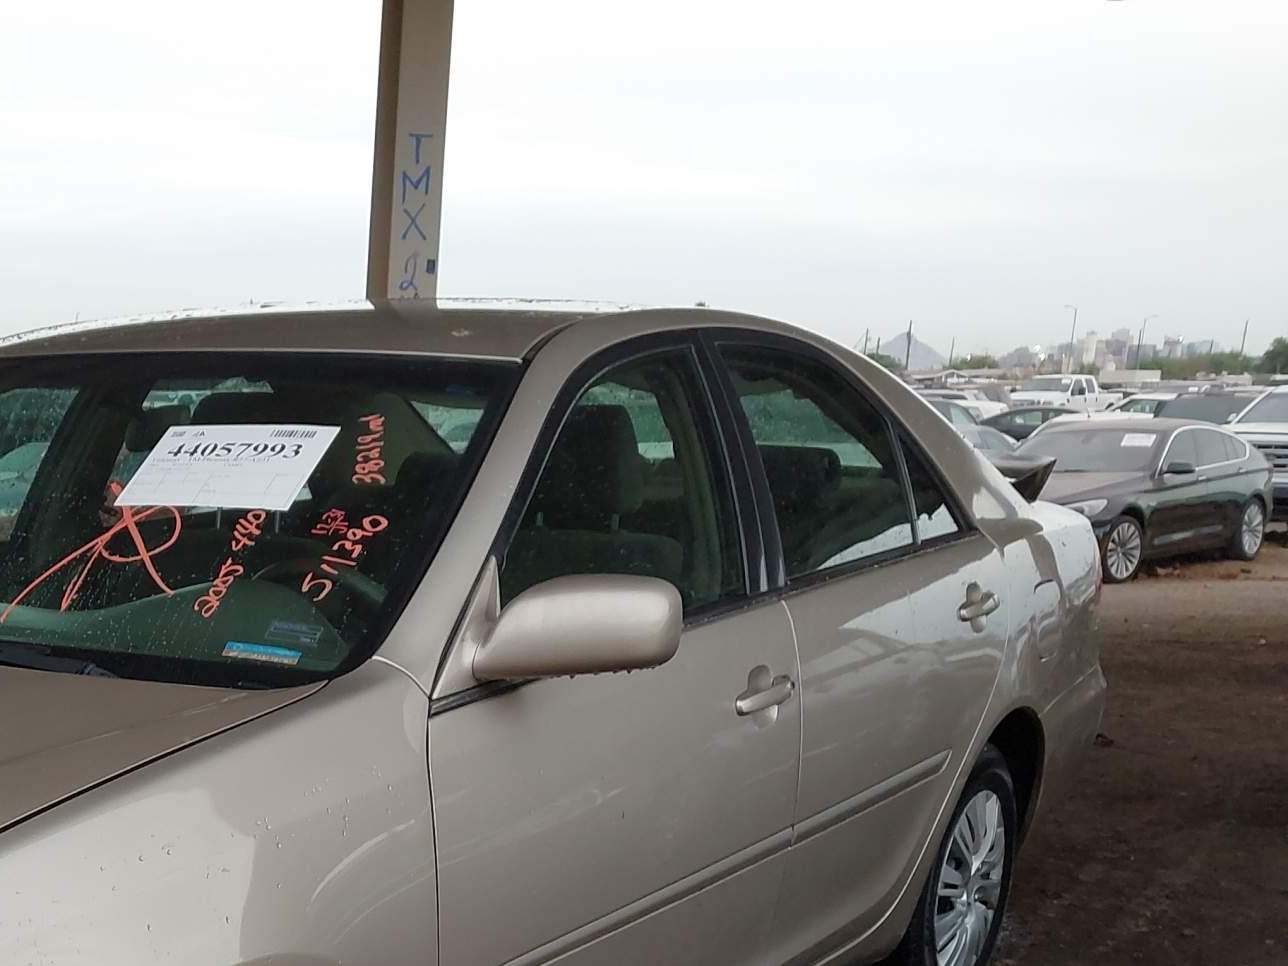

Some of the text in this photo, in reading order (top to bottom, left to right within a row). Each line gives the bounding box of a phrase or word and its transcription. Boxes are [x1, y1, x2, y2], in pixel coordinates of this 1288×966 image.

[168, 442, 304, 459] 44057993
[194, 557, 245, 618] 2005
[301, 515, 389, 602] 511390
